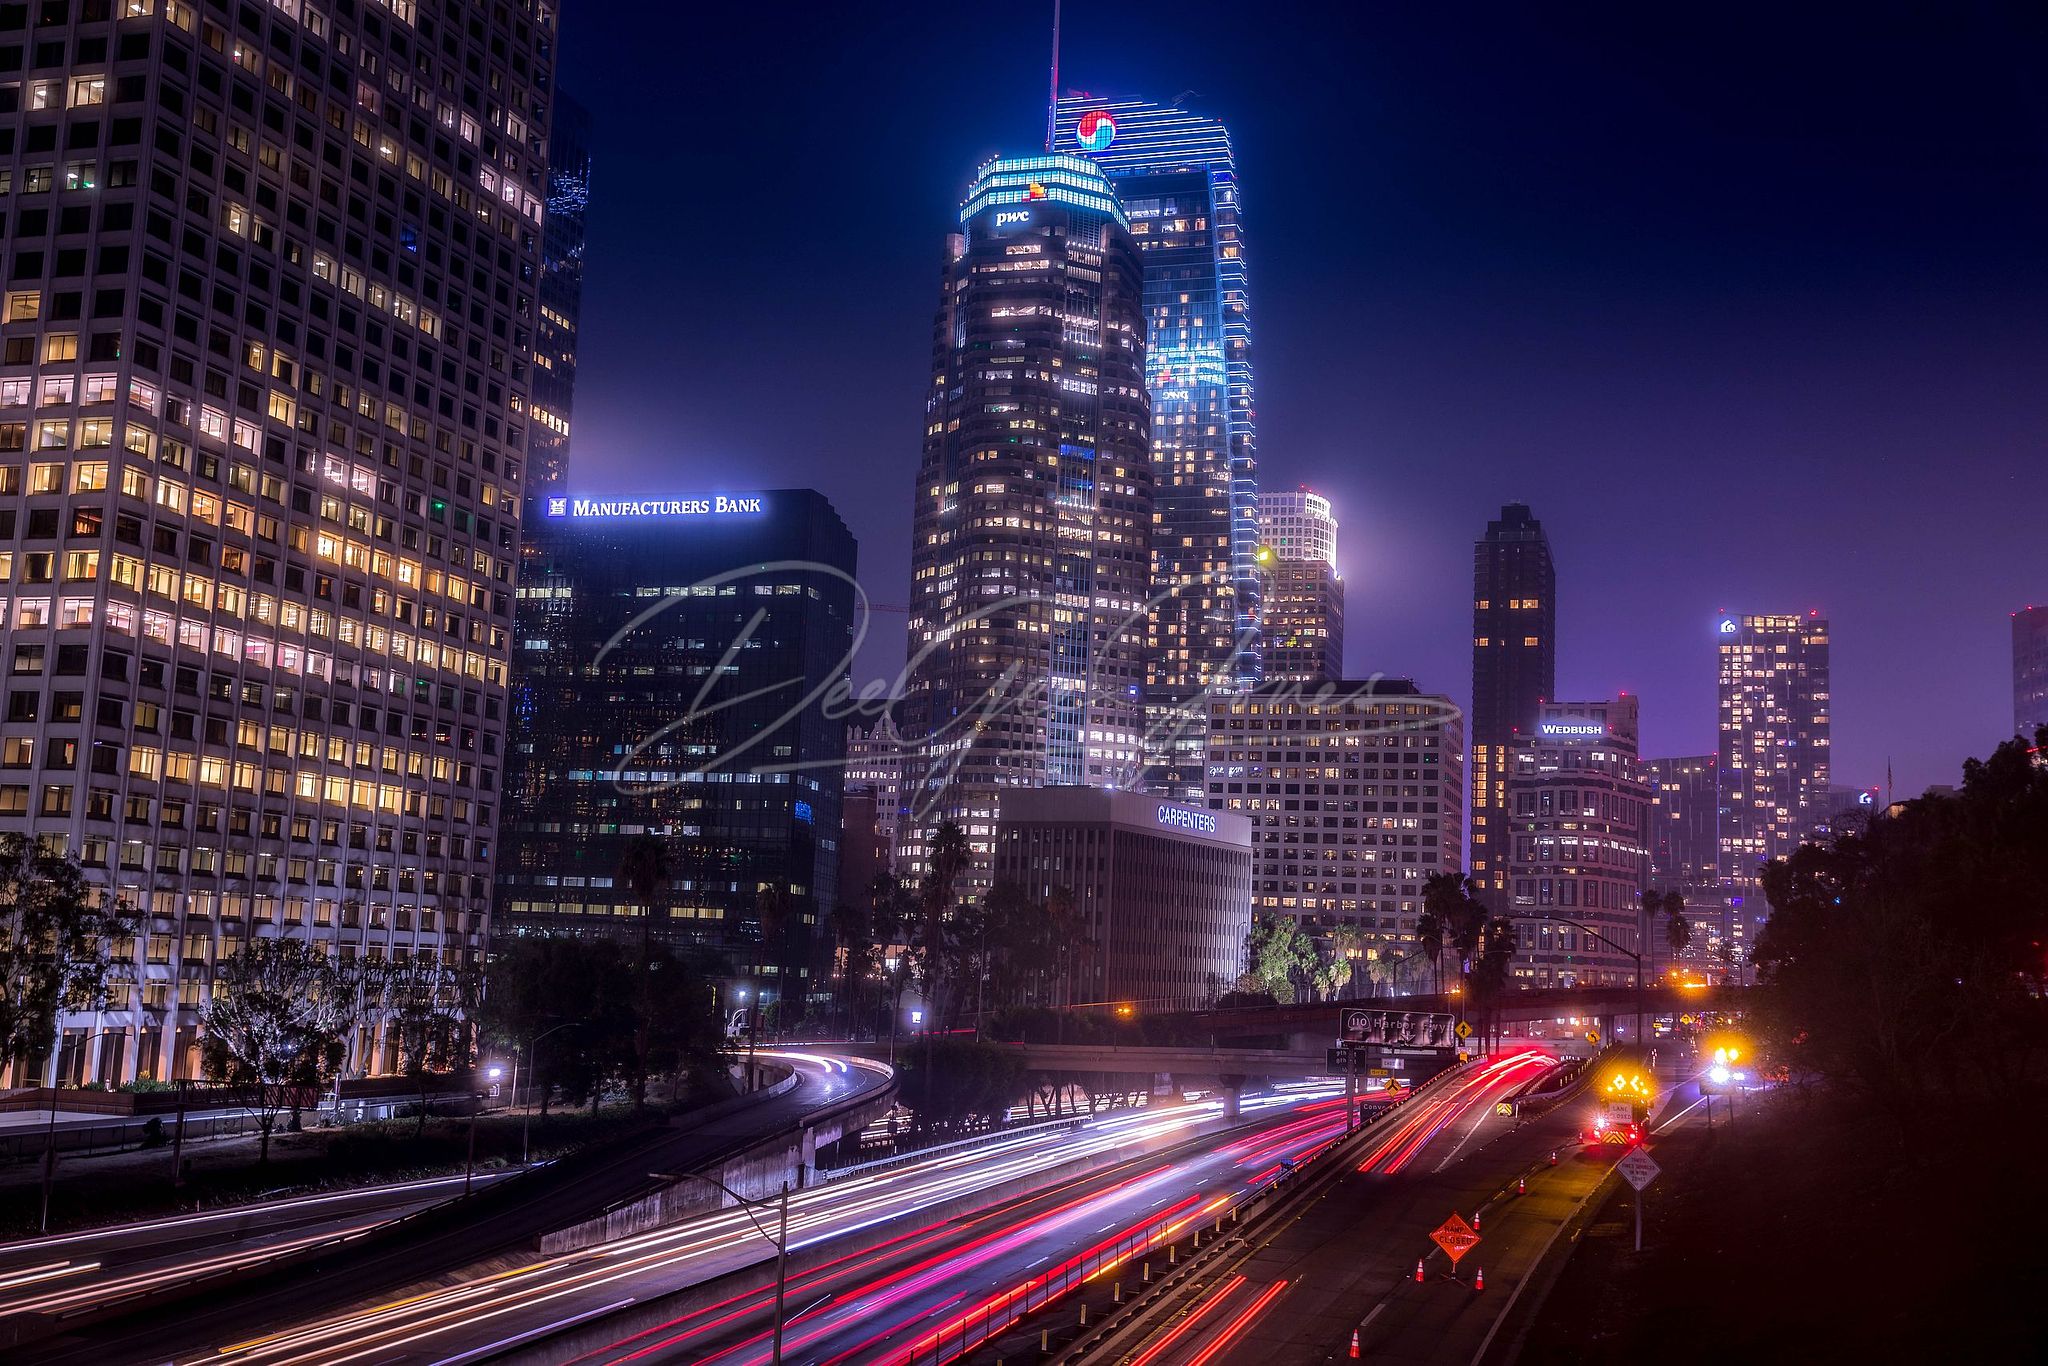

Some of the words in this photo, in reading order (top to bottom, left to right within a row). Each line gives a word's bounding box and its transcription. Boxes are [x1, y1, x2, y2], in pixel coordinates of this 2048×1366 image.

[996, 210, 1029, 227] pwc
[573, 500, 709, 516] MANUFACTURERS
[715, 496, 760, 513] BANK
[1542, 724, 1602, 735] WEDBUSH
[1157, 805, 1216, 833] CARPENTERS
[1352, 1017, 1367, 1026] 110
[1374, 1018, 1416, 1029] Harbor
[1444, 1225, 1465, 1233] RAMP
[1439, 1236, 1472, 1245] CLOSED
